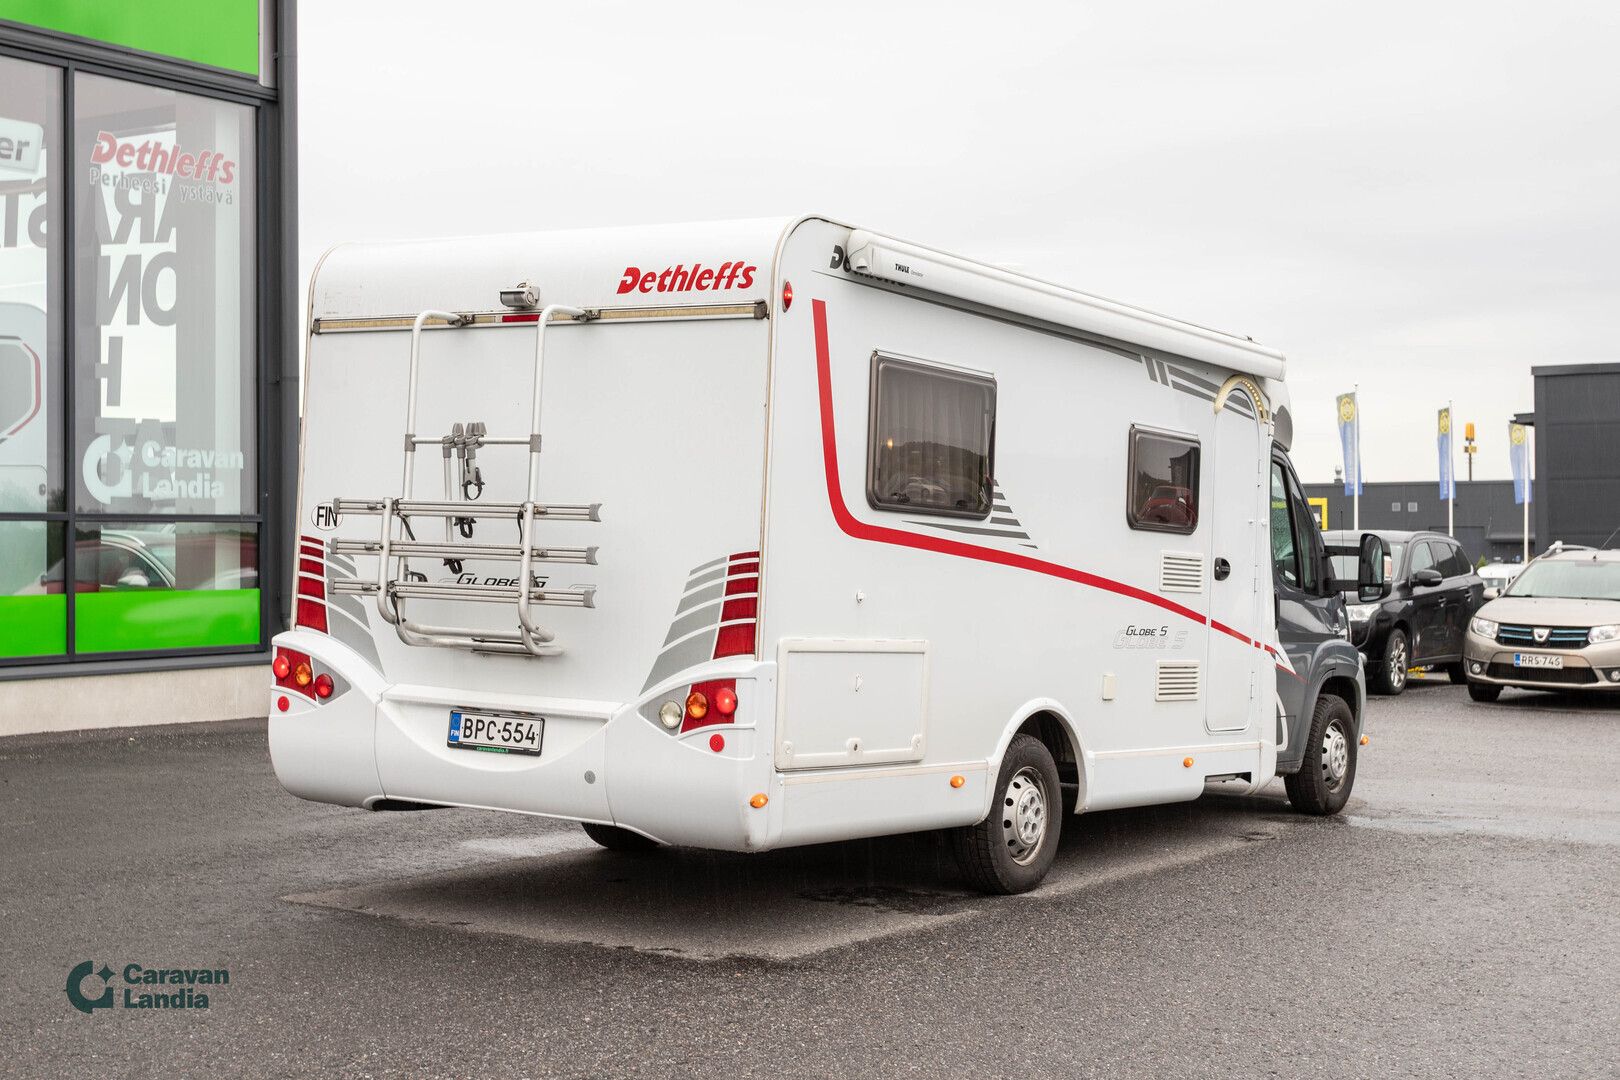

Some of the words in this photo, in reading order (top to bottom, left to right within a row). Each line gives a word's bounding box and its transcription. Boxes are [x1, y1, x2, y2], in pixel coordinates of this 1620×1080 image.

[91, 131, 235, 184] Dethleffs
[90, 168, 167, 195] Perheesi
[180, 184, 233, 205] ystävä
[616, 261, 756, 295] Dethleffs
[895, 263, 910, 274] THULE
[142, 440, 243, 469] Caravan
[142, 472, 225, 498] Landia
[316, 505, 338, 527] FIN
[1126, 625, 1157, 636] GLOBE
[1160, 626, 1168, 636] S
[463, 718, 536, 745] BPC-554
